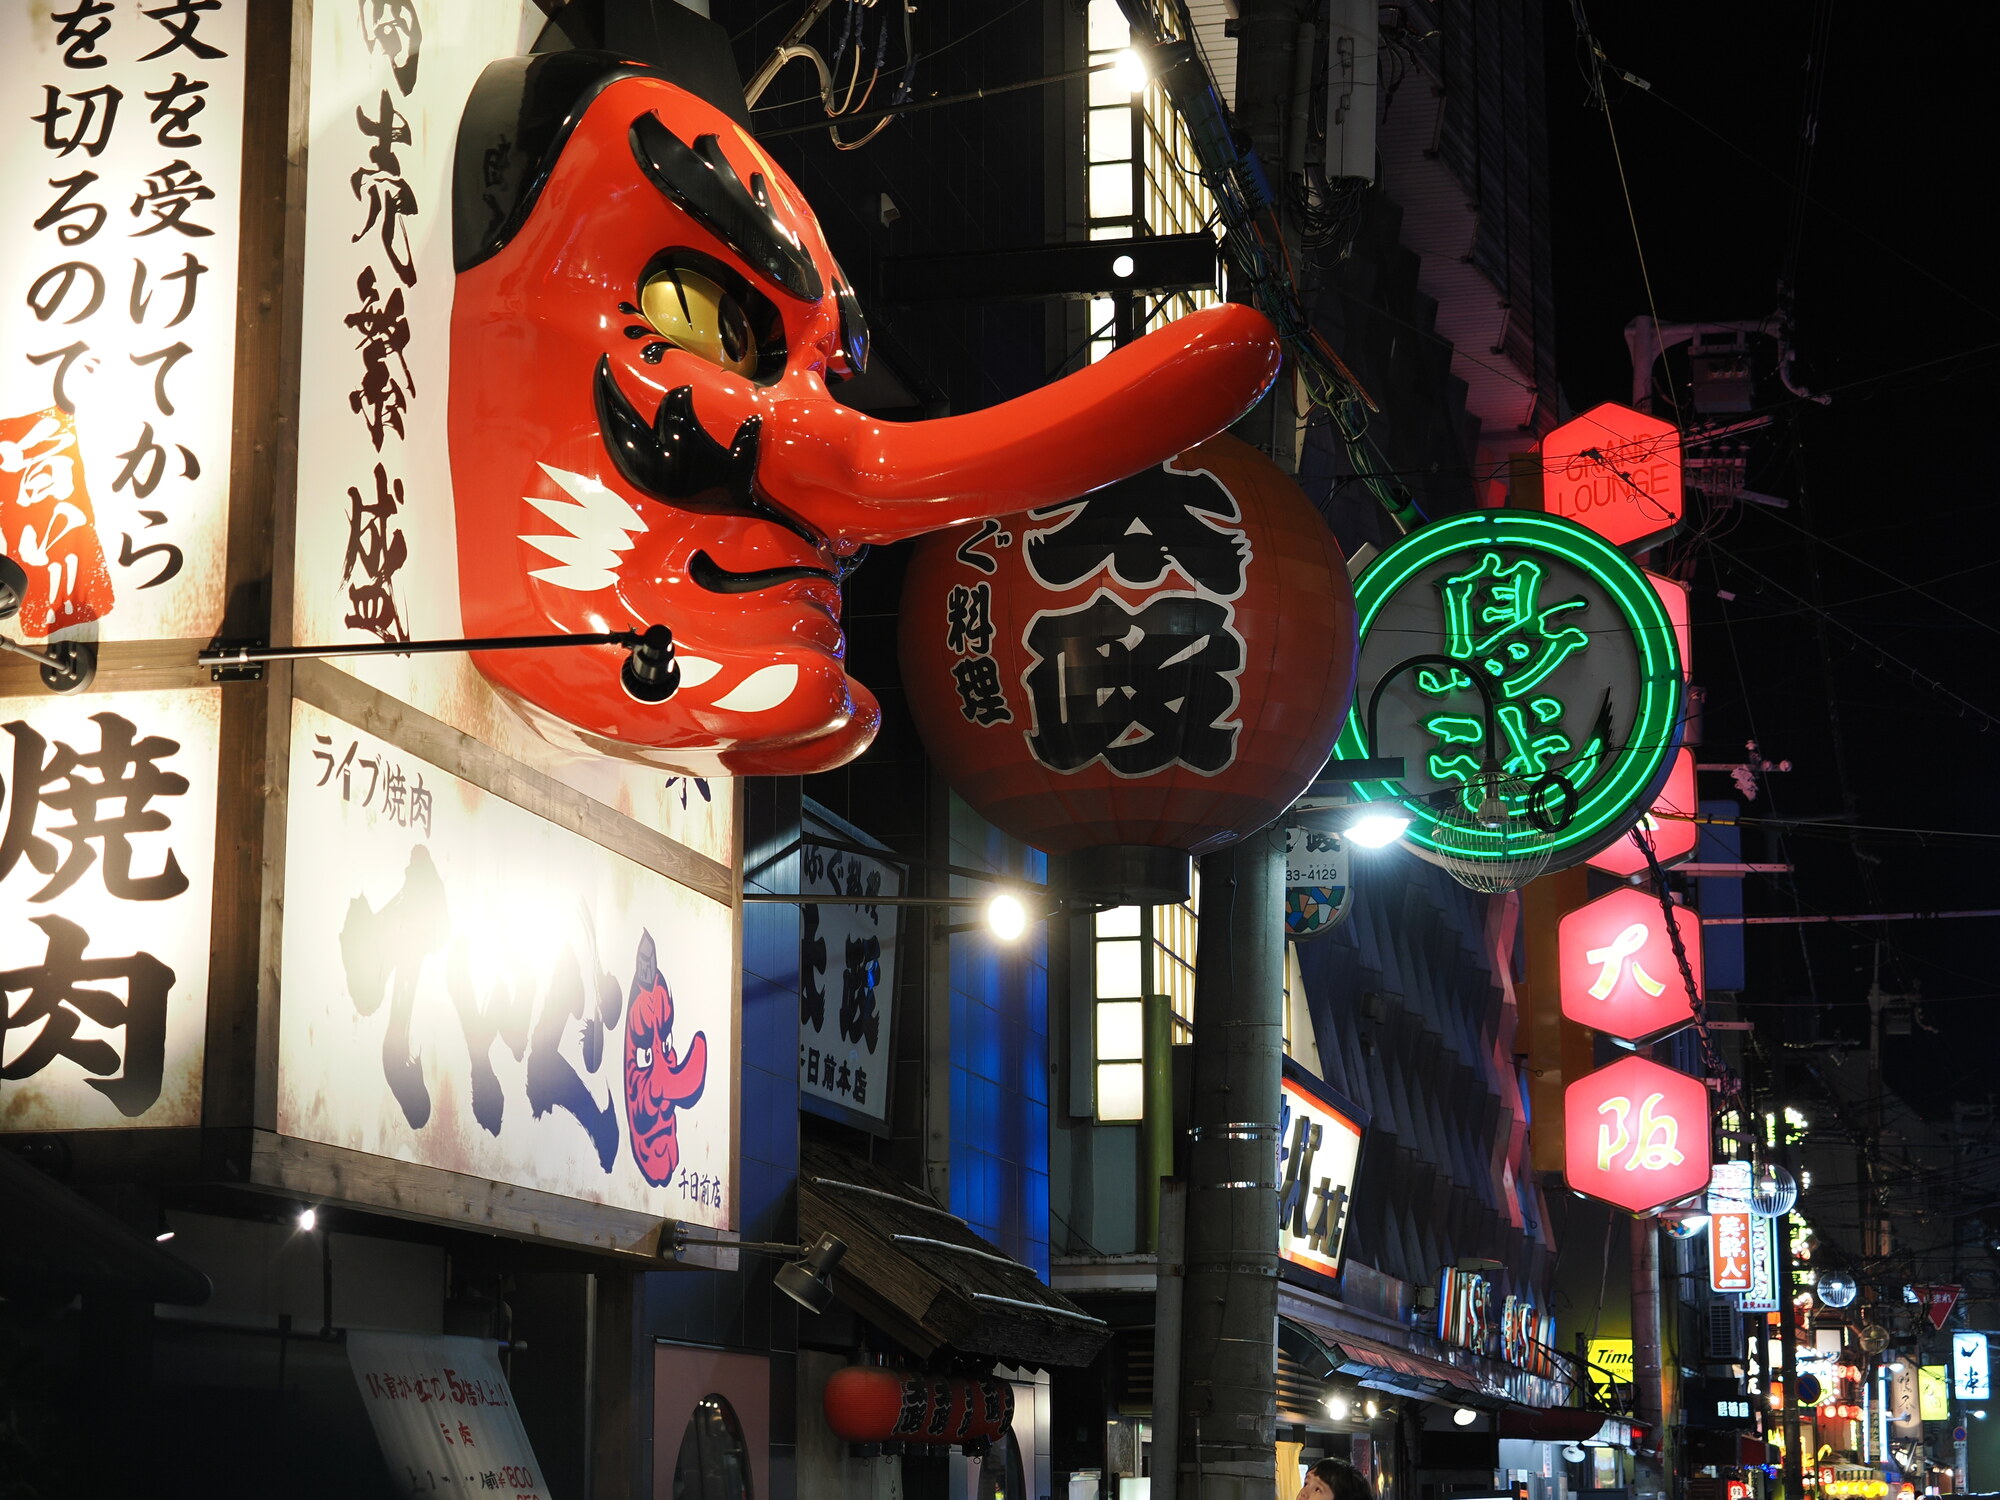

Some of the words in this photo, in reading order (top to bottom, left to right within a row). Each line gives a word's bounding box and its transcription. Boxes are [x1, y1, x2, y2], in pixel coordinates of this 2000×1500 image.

[1566, 434, 1655, 482] GRAND
[1557, 464, 1670, 516] LOUNGE
[312, 733, 433, 839] ライブ焼肉
[0, 712, 190, 1117] 焼肉
[677, 1169, 722, 1209] 千日前店
